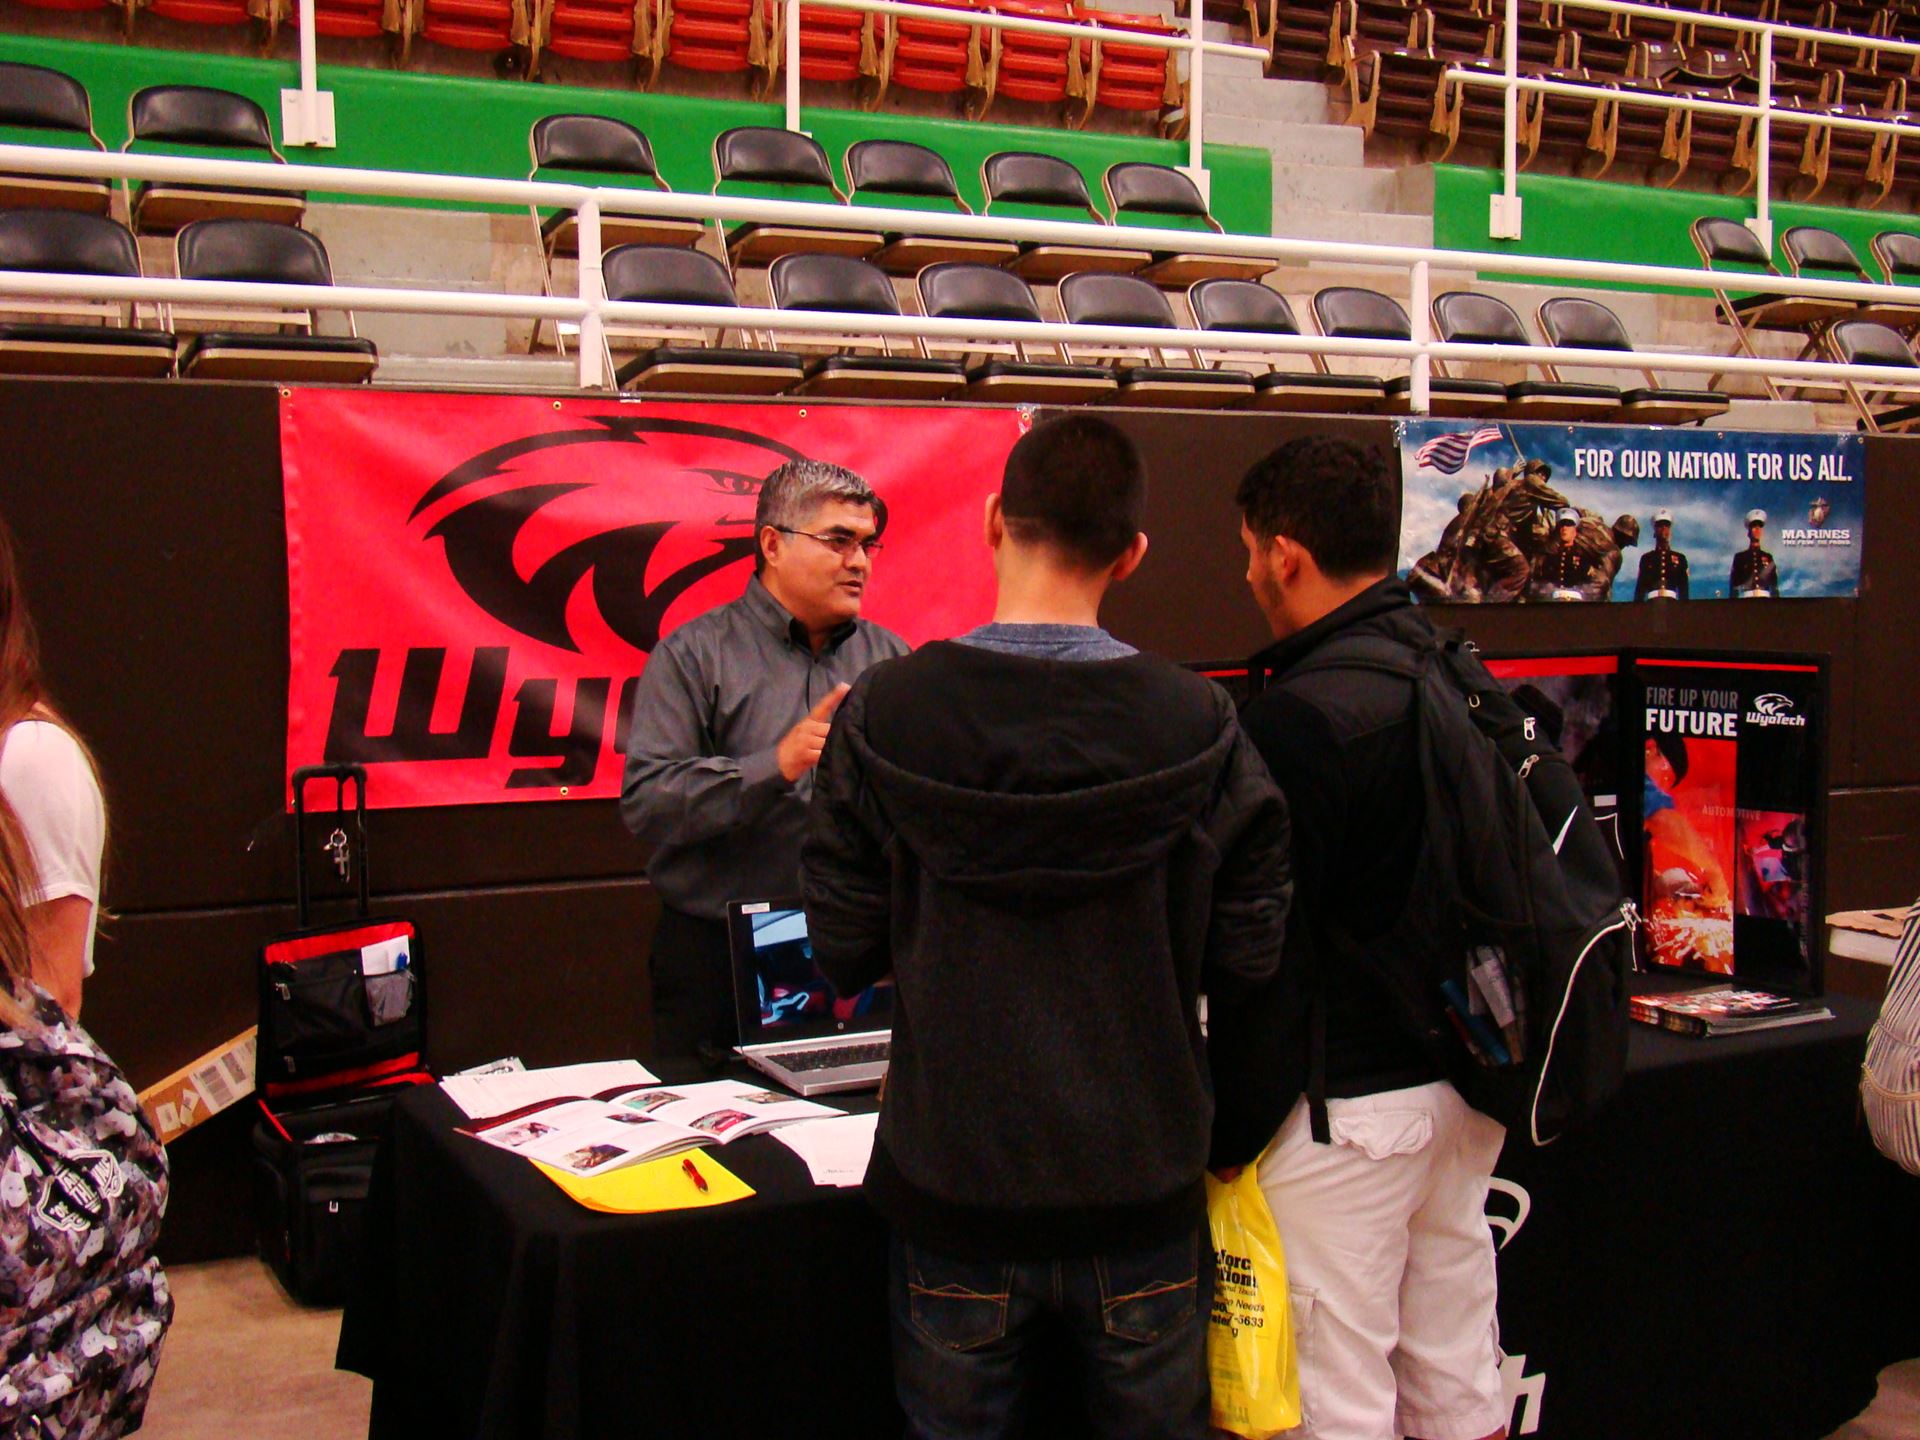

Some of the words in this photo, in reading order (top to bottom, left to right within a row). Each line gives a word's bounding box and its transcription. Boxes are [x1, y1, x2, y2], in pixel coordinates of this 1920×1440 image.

[1574, 448, 1614, 478] FOR
[1620, 449, 1661, 479] OUR
[1667, 451, 1741, 480] NATION.
[1747, 453, 1783, 480] FOR
[1789, 454, 1813, 481] US
[1818, 454, 1852, 481] ALL.
[1782, 529, 1851, 539] MARINES
[1646, 686, 1675, 706] FIRE
[1680, 688, 1697, 707] UP
[1702, 690, 1738, 709] YOUR
[324, 647, 640, 789] Wy
[1645, 708, 1738, 737] FUTURE
[1746, 711, 1805, 726] WyoTech
[1702, 804, 1761, 821] AUTOMOTIVE
